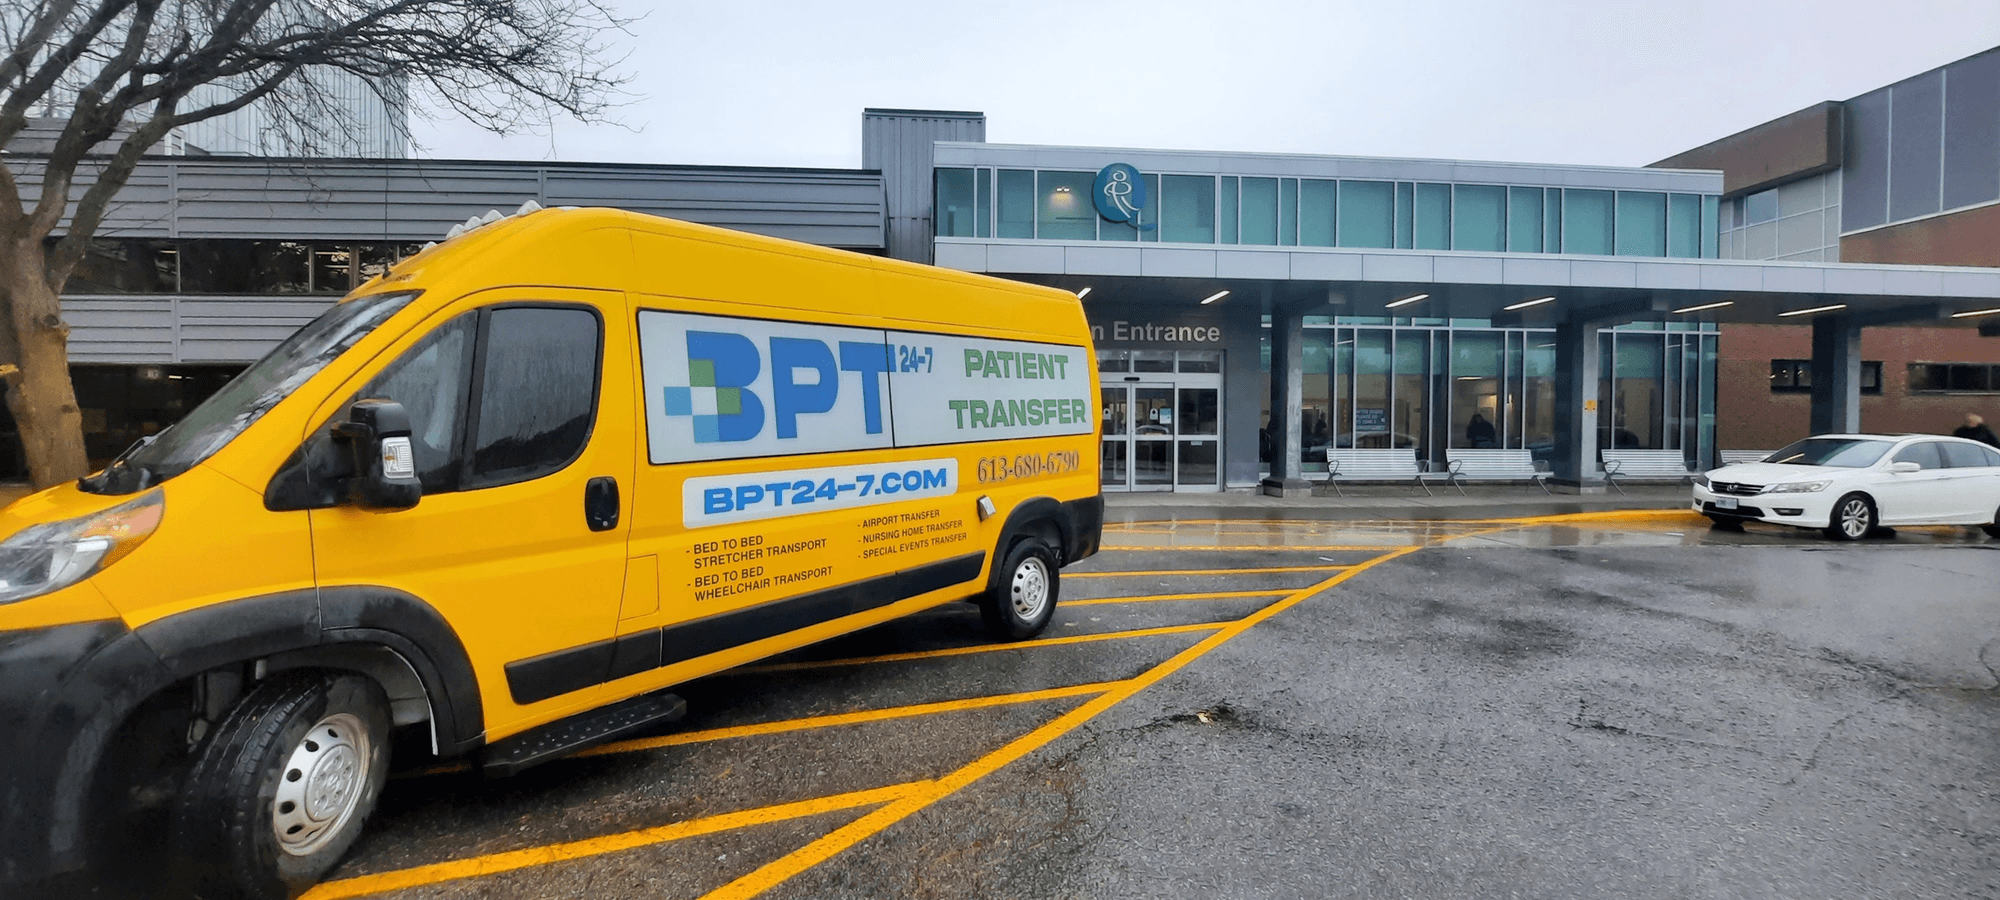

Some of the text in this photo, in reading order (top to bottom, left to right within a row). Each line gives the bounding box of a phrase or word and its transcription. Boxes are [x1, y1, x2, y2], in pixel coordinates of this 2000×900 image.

[1113, 320, 1221, 342] Entrance
[963, 348, 1069, 380] PATIENT
[686, 330, 933, 444] BPT 24-7
[948, 398, 1087, 429] TRANSFER
[977, 449, 1080, 484] 613-680-6790
[703, 468, 947, 515] BPT24-7.COM
[862, 515, 898, 528] AIRPORT
[900, 509, 940, 523] TRANSFER
[863, 529, 900, 544] NURSING
[901, 525, 925, 537] HOME
[926, 519, 963, 533] TRANSFER
[693, 541, 719, 555] BED
[721, 538, 738, 550] TO
[740, 534, 764, 548] BED
[694, 538, 828, 569] STRETCHER TRANSPORT
[863, 545, 898, 559] SPECIAL
[899, 539, 930, 552] EVENTS
[931, 532, 967, 546] TRANSFER
[694, 573, 720, 588] BED
[722, 570, 739, 582] TO
[741, 565, 764, 580] BED
[694, 566, 833, 602] WHEELCHAIR TRANSPORT
